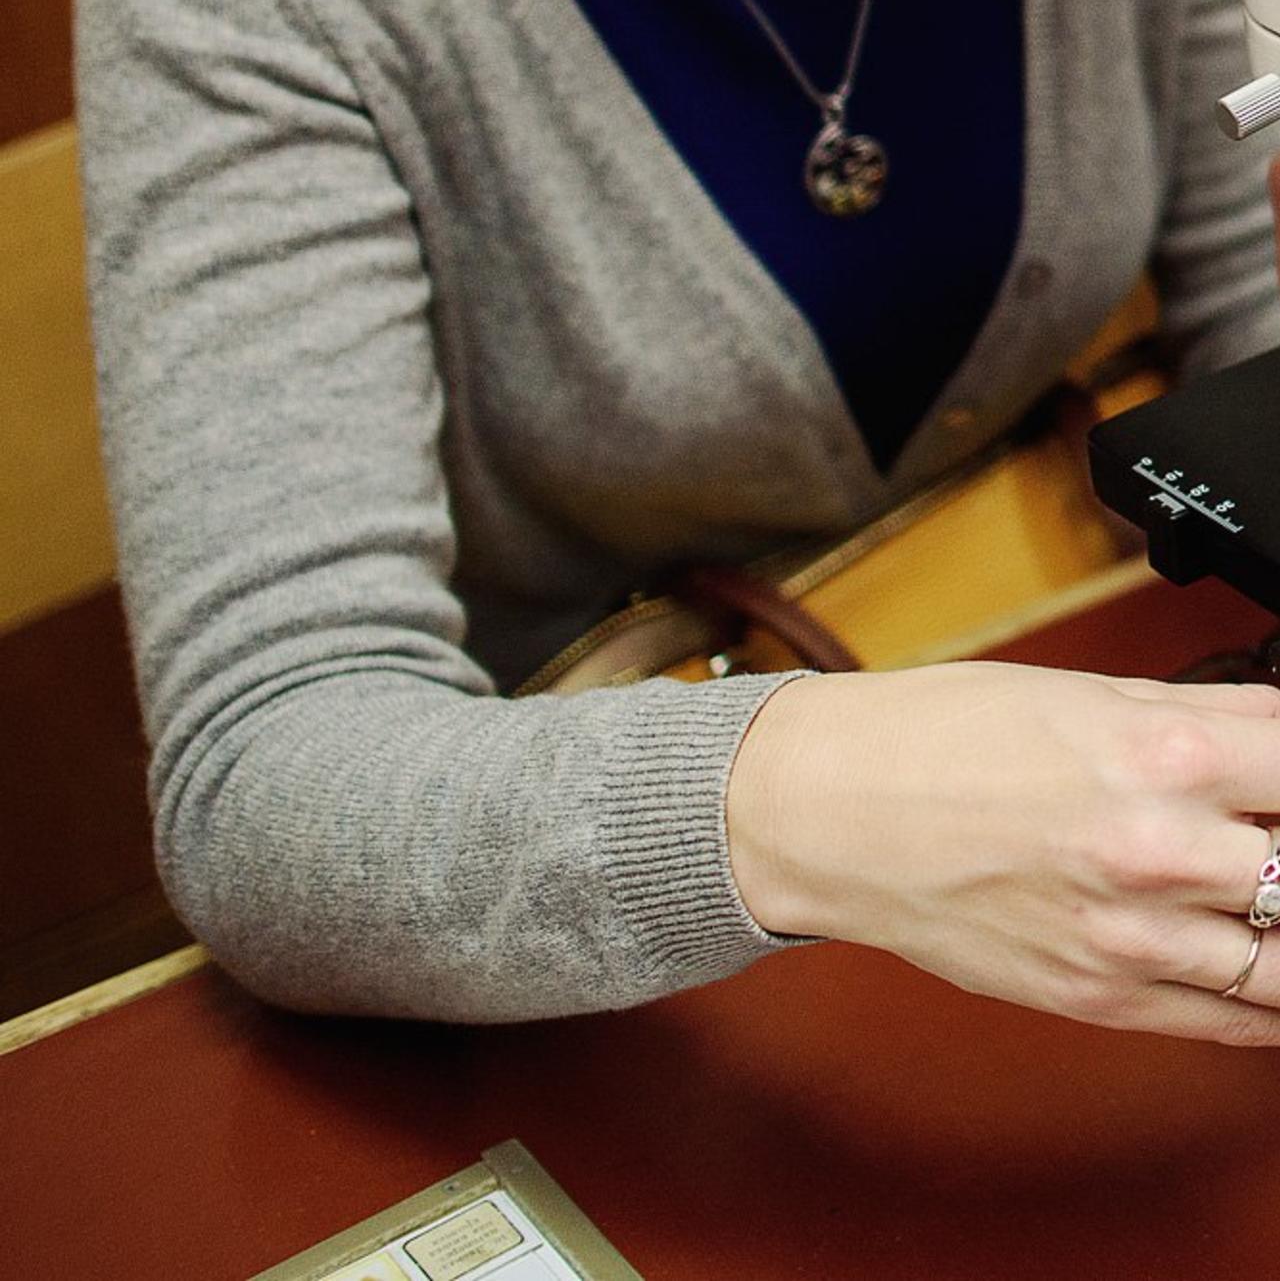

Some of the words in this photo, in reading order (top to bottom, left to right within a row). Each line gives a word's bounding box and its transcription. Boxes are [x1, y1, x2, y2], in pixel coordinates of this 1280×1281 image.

[1140, 456, 1153, 466] 0
[1164, 469, 1184, 481] 10
[1189, 483, 1210, 497] 20
[1215, 499, 1236, 513] 30
